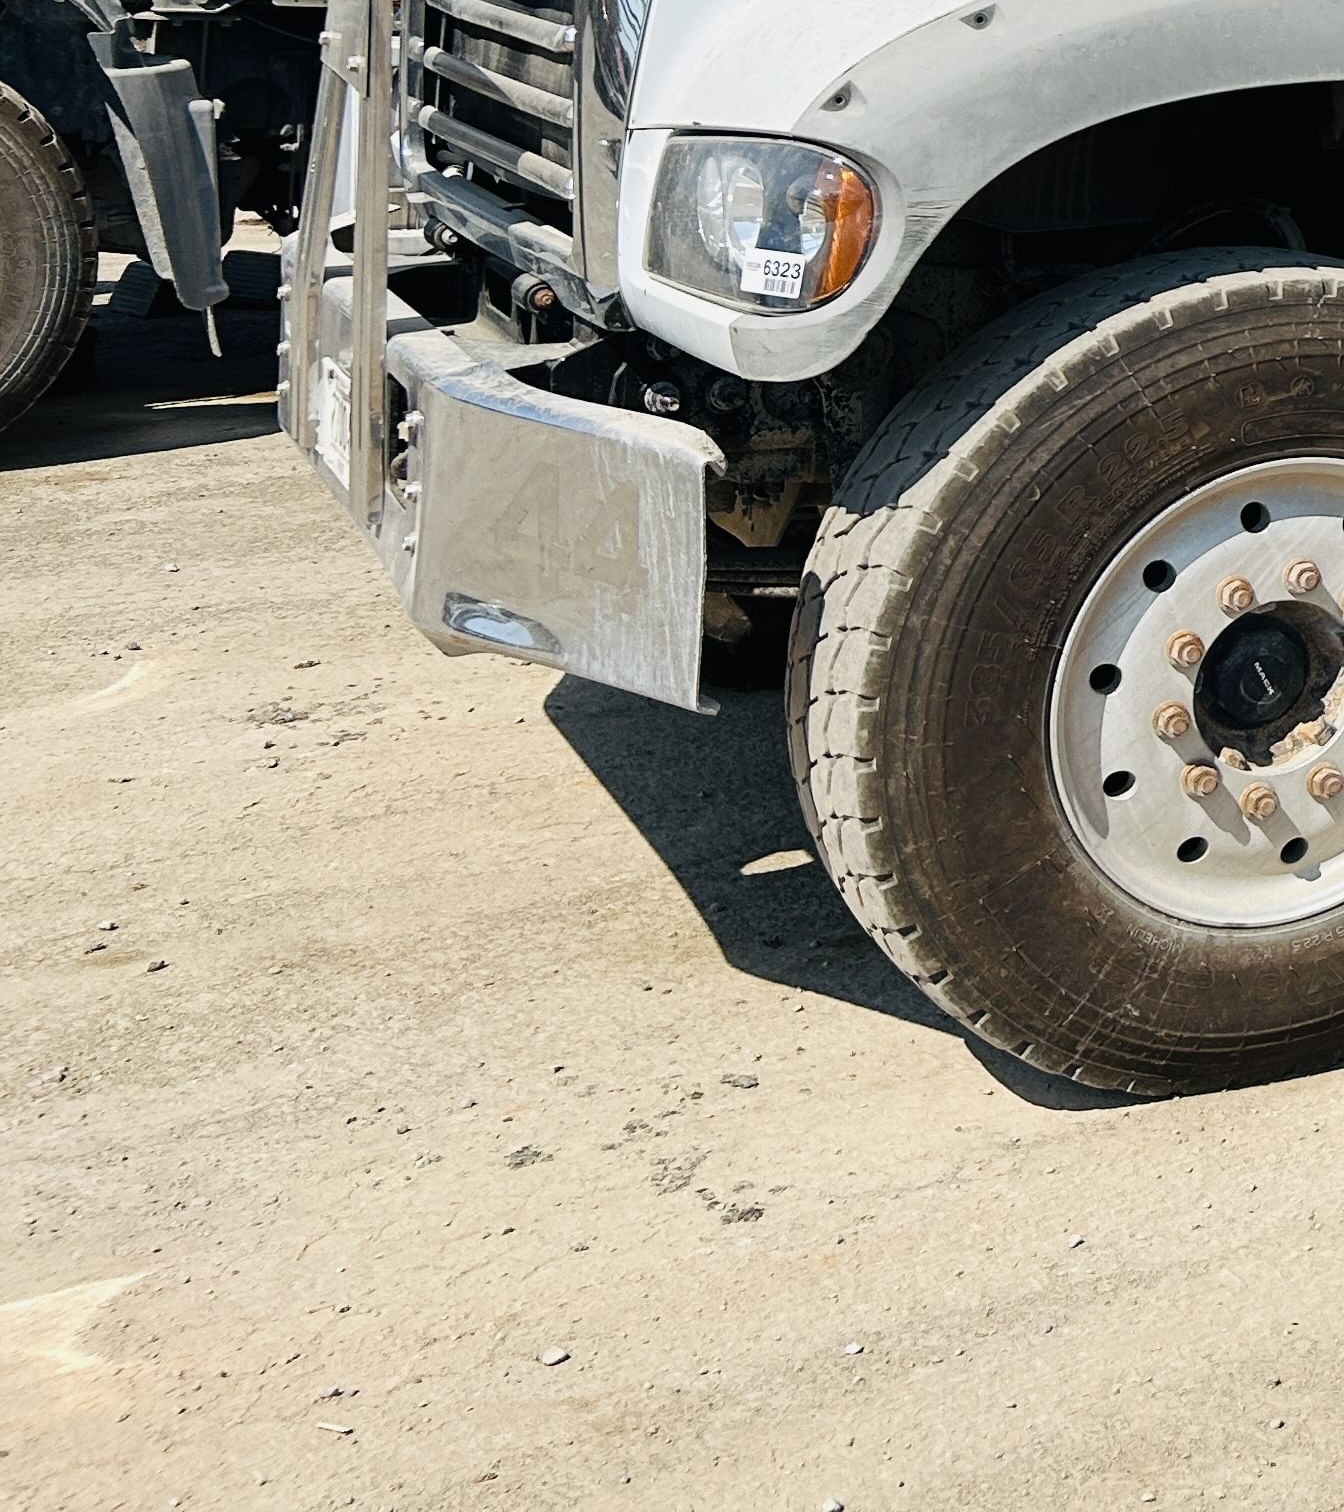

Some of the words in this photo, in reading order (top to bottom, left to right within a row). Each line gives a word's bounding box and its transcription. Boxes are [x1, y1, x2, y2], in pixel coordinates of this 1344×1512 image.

[763, 259, 802, 280] 6323
[1254, 661, 1275, 696] MACK
[1126, 924, 1187, 954] MICHELIN
